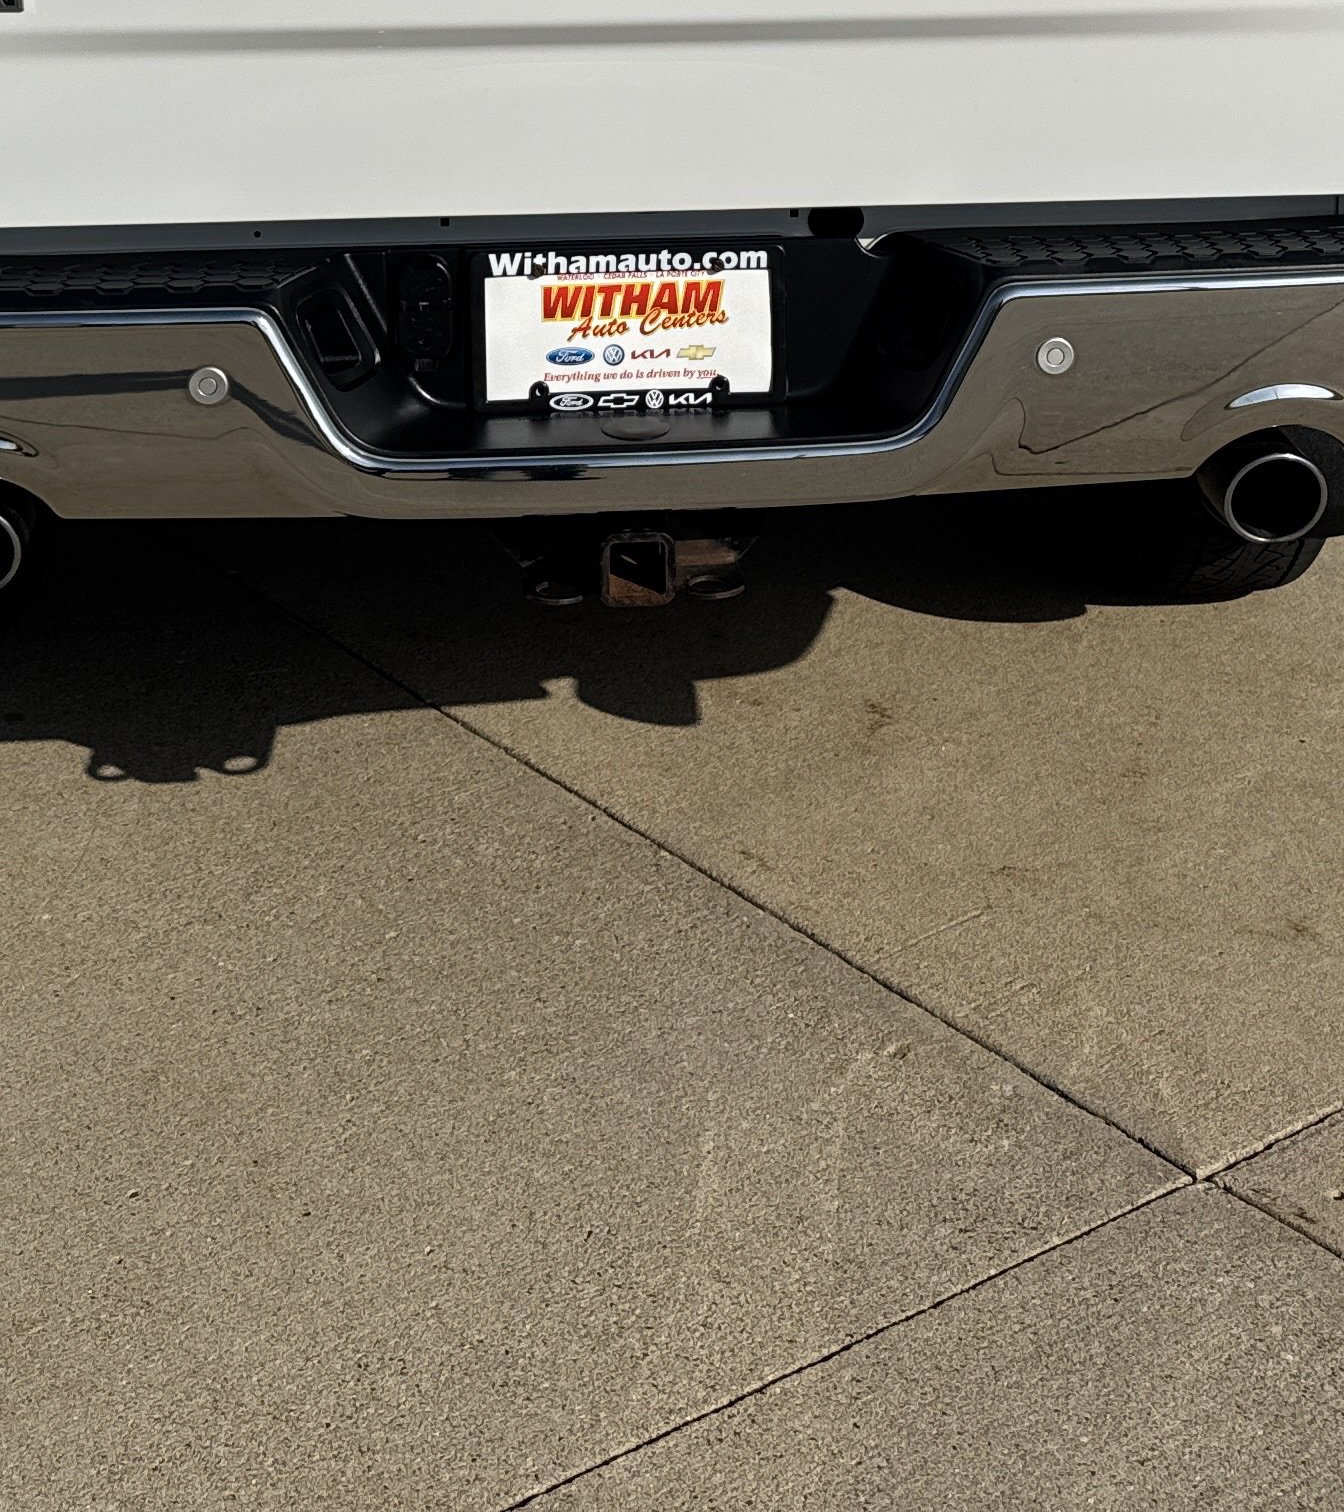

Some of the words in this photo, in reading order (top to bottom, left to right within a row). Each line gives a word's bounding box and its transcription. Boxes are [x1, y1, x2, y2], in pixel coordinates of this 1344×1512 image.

[542, 280, 723, 321] WITHAM
[567, 316, 630, 342] Auto
[639, 307, 729, 335] Centers
[631, 348, 671, 359] KIA
[544, 371, 601, 383] Everything
[603, 372, 617, 380] we
[620, 370, 633, 380] do
[646, 368, 680, 379] driven
[683, 368, 696, 379] by
[668, 392, 712, 405] KIA
